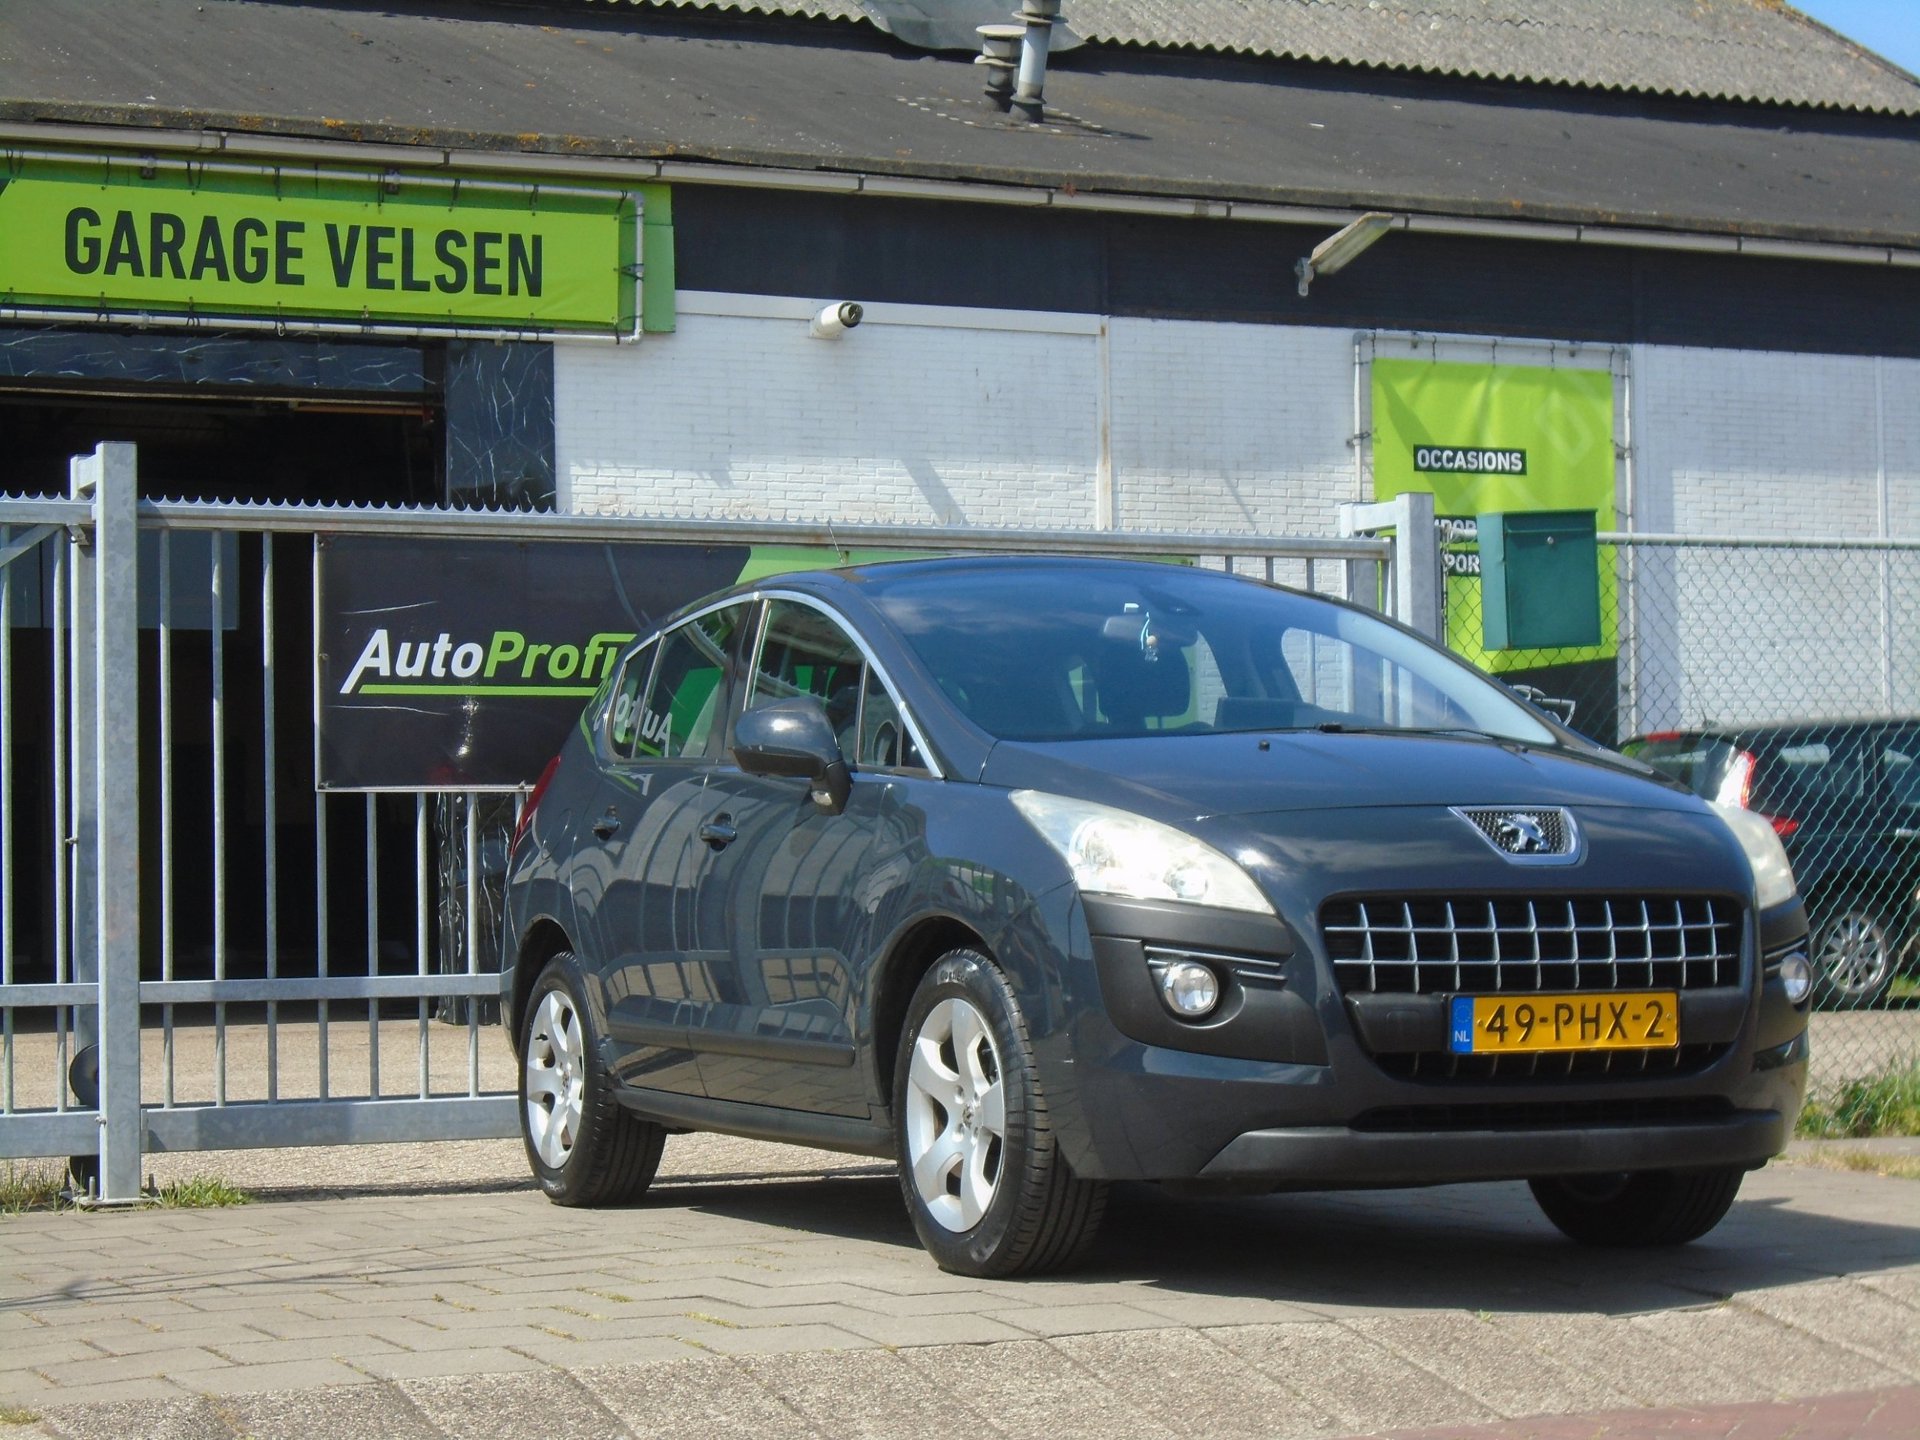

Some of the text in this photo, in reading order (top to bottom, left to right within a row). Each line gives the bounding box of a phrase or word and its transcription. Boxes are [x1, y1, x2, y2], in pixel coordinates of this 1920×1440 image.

[65, 206, 543, 297] GARAGE VELSEN
[1417, 449, 1523, 471] OCCASIONS
[1454, 1030, 1471, 1043] NL
[1485, 1000, 1665, 1043] 49-PHX-2
